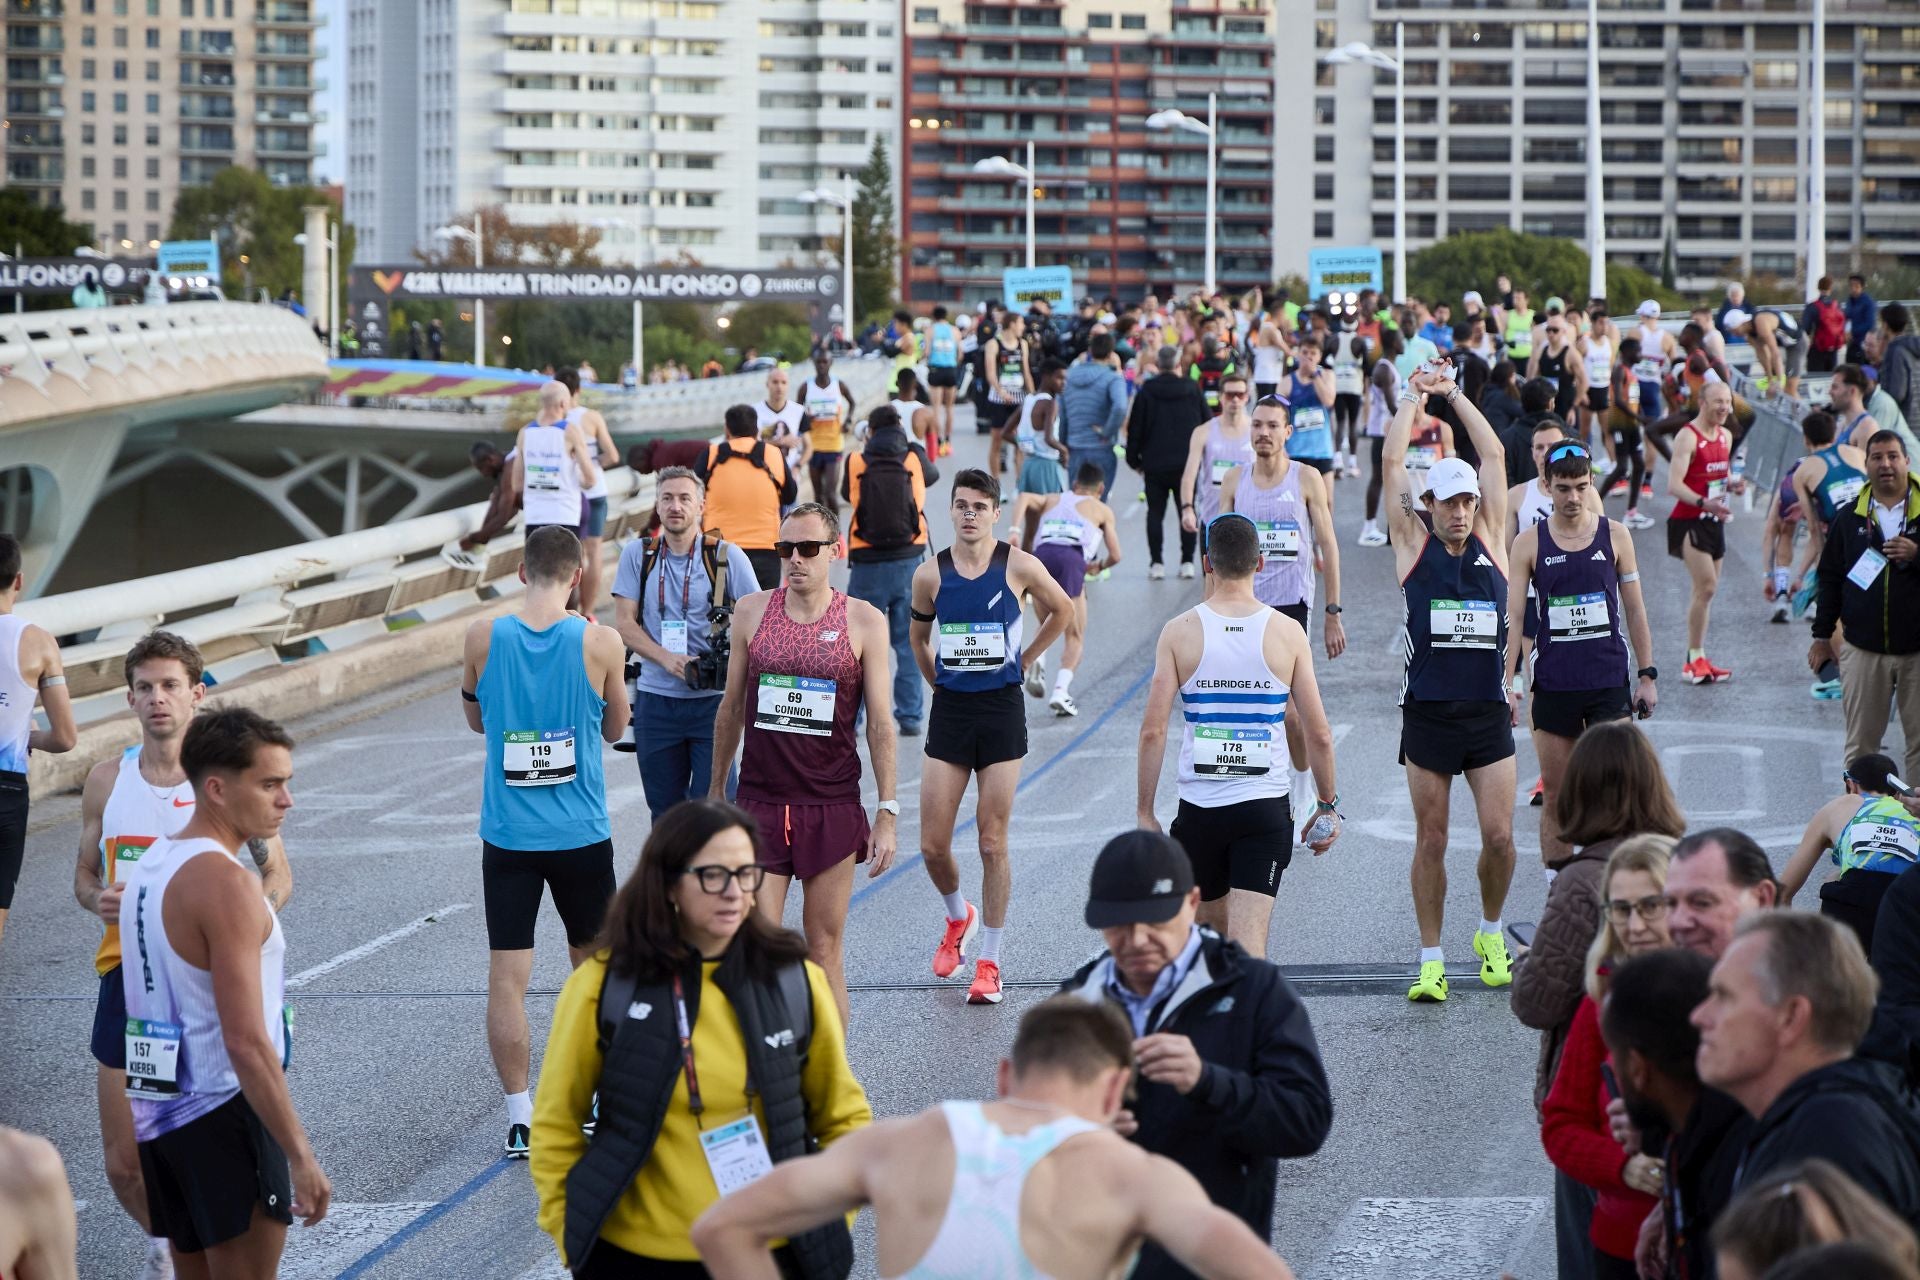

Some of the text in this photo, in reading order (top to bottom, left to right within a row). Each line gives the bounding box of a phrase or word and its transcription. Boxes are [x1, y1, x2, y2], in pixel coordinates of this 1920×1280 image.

[0, 264, 99, 287] LFONSO
[402, 271, 739, 296] 42K VALENCIA TRINIDAD ALFONSO
[1266, 533, 1277, 541] 62
[1570, 607, 1586, 616] 141
[1456, 613, 1474, 622] 173
[1454, 625, 1475, 633] Chris
[965, 636, 976, 646] 35
[954, 648, 989, 657] HAWKINS
[1253, 681, 1273, 689] A.C.
[788, 691, 802, 703] 69
[775, 704, 812, 717] CONNOR
[530, 745, 551, 756] 119
[1222, 743, 1242, 752] 178
[532, 759, 550, 769] Olle
[1216, 755, 1247, 764] HOARE
[1876, 826, 1897, 835] 368
[134, 1042, 151, 1057] 157
[129, 1060, 156, 1076] KIEREN
